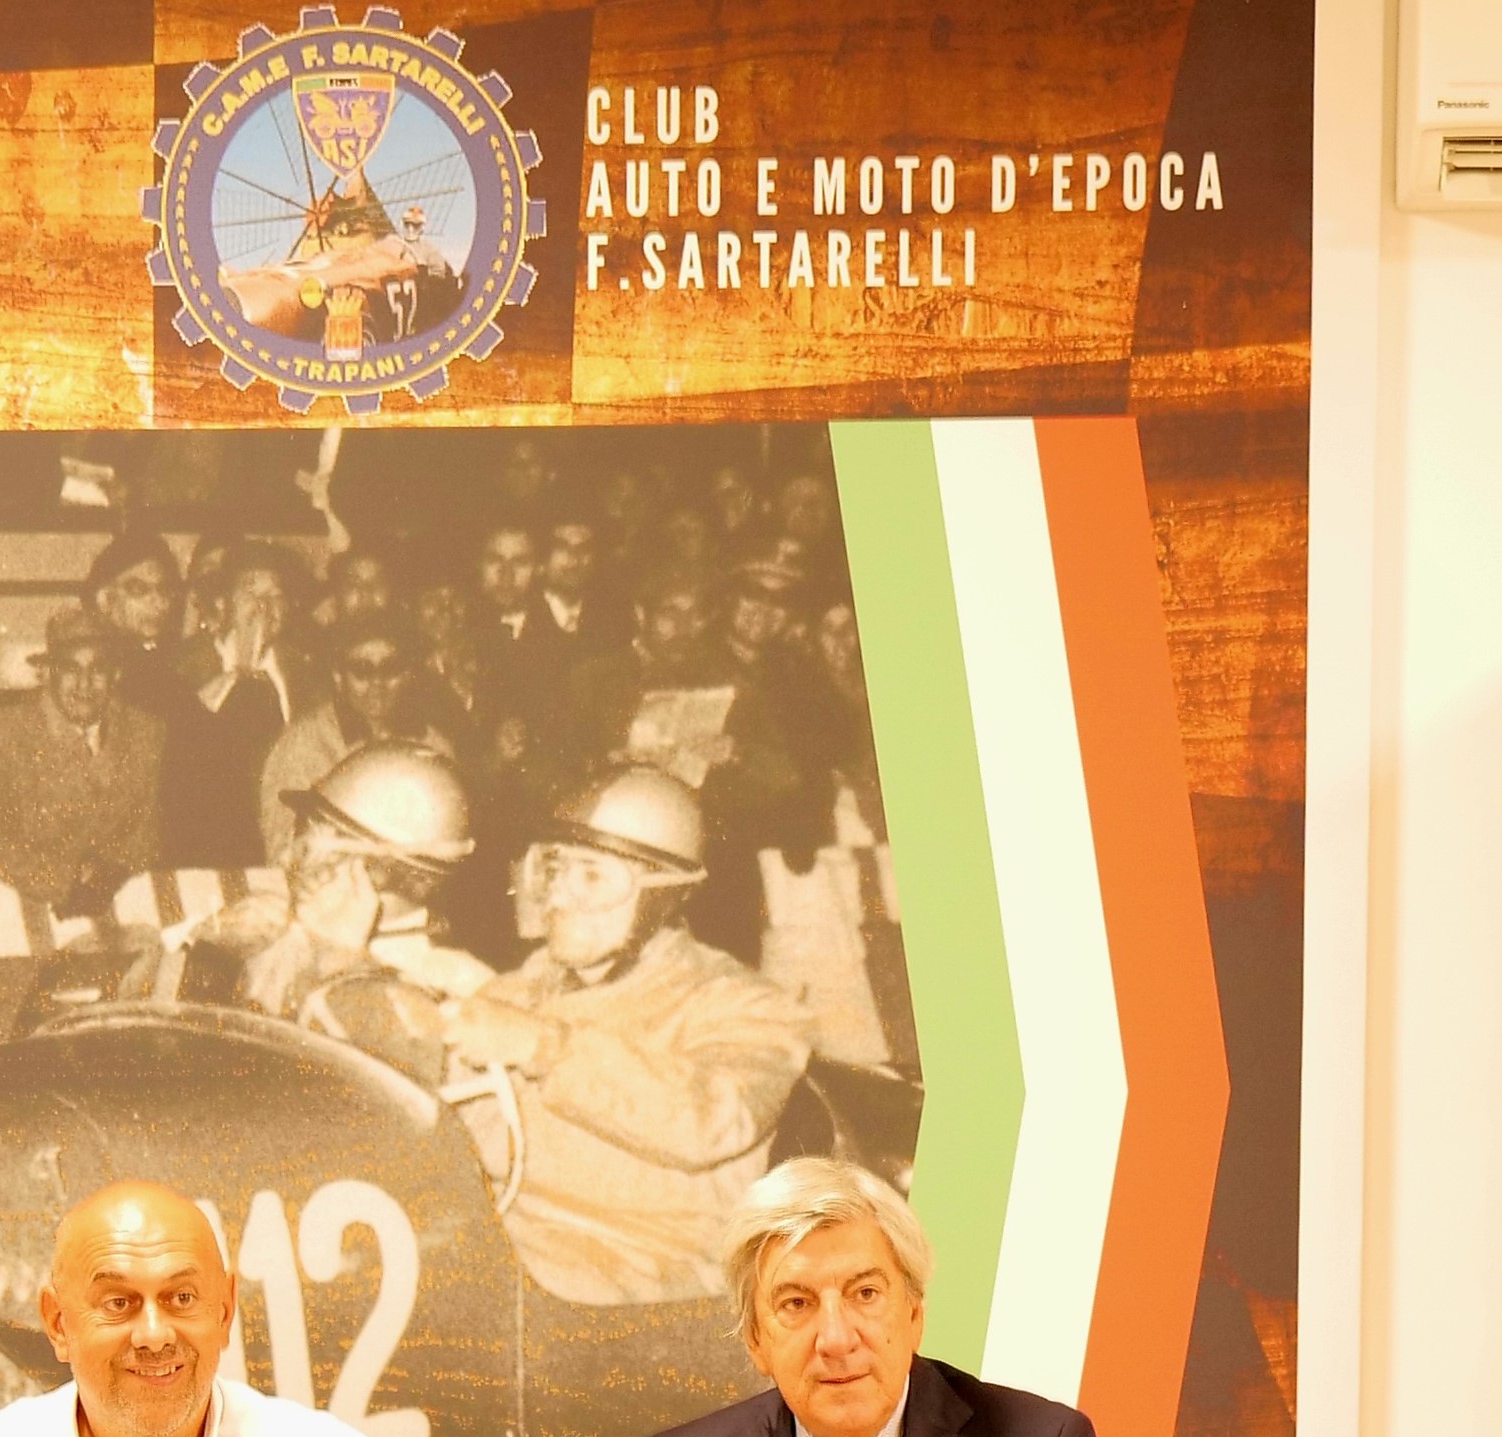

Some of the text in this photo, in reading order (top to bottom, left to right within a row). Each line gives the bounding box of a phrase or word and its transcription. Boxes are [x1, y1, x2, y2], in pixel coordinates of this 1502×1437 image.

[331, 42, 486, 136] SARTARELLI
[587, 86, 721, 144] CLUB
[1437, 99, 1490, 109] Panasonic
[322, 138, 368, 170] ASI
[585, 156, 722, 218] AUTO
[757, 157, 779, 217] E
[813, 155, 956, 216] MOTO
[587, 227, 977, 290] F.SARTARELLI
[292, 354, 406, 384] TRAPANI
